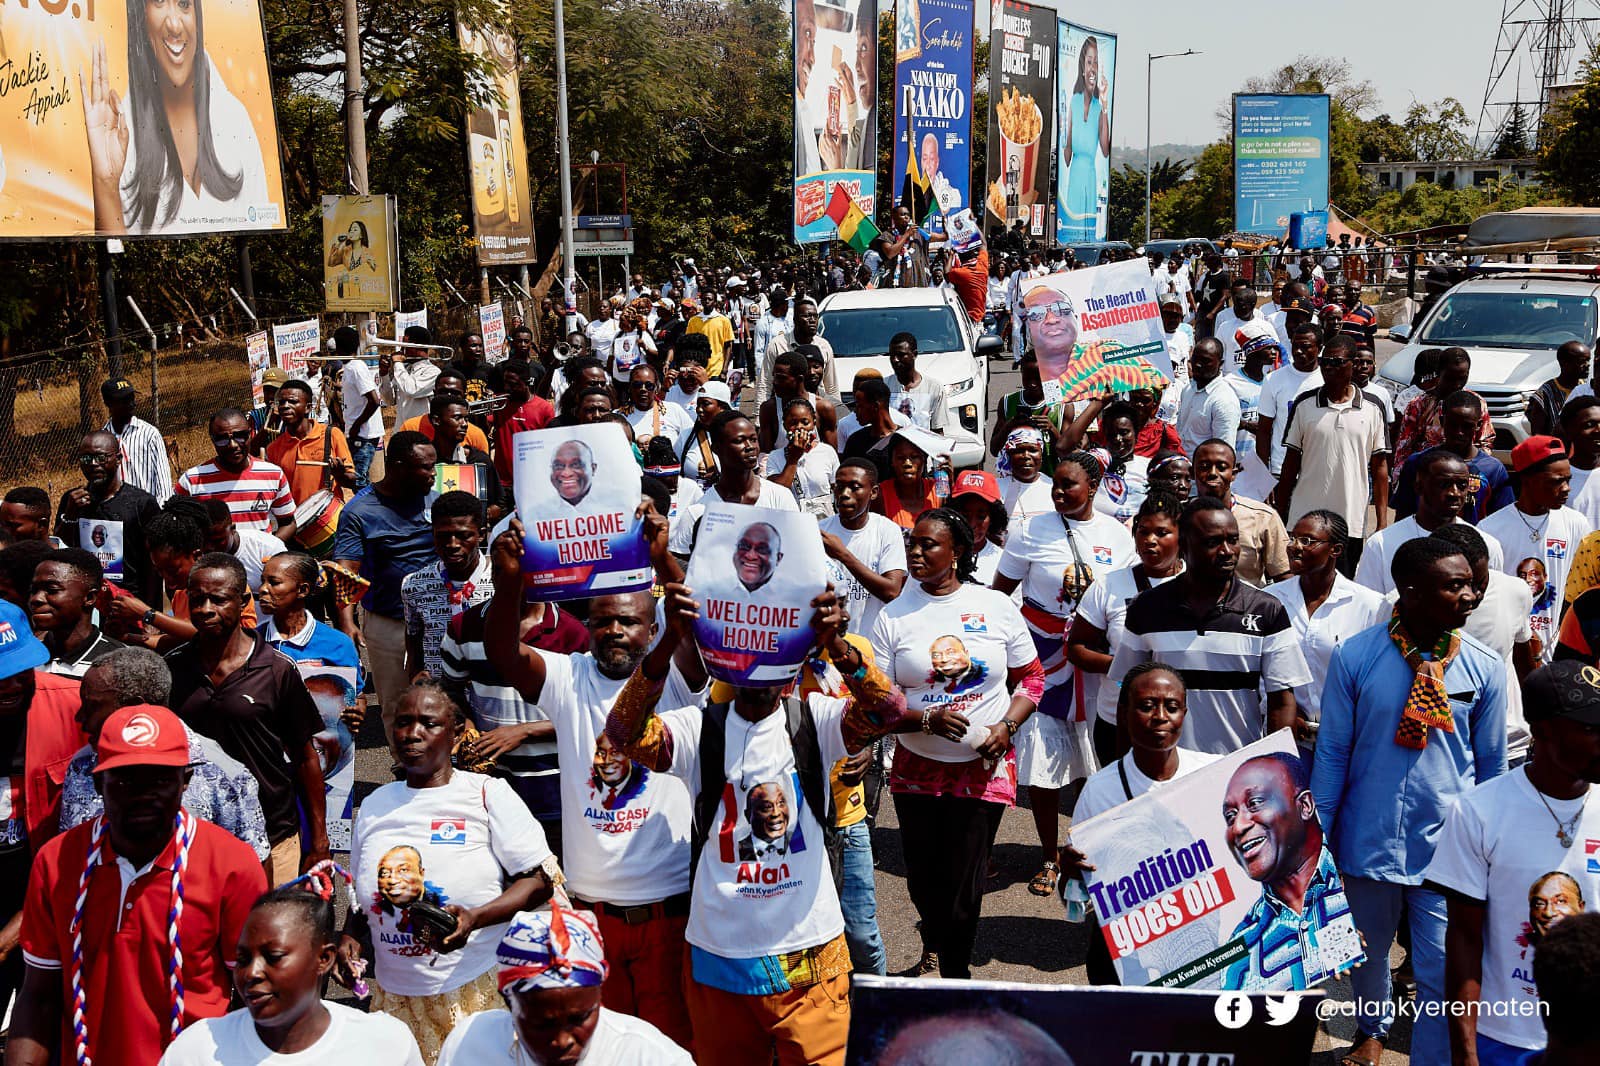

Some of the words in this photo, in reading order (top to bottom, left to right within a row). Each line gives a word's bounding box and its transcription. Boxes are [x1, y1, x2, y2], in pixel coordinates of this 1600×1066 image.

[0, 53, 49, 96] Jackie
[911, 70, 934, 86] NANA
[936, 72, 957, 88] KOFI
[23, 77, 71, 126] Appiah
[1085, 298, 1105, 312] The
[1105, 291, 1135, 309] Heart
[1136, 288, 1147, 301] of
[1081, 301, 1160, 332] Asanteman
[536, 512, 626, 542] WELCOME
[558, 538, 612, 564] HOME
[706, 598, 801, 630] WELCOME
[722, 625, 779, 653] HOME
[921, 694, 952, 703] ALAN
[953, 692, 983, 702] CASH
[584, 807, 616, 822] ALAN
[616, 806, 650, 820] CASH
[602, 821, 632, 834] 2024
[736, 862, 790, 885] Alan
[1088, 838, 1214, 921] Tradition
[736, 886, 755, 896] John
[1110, 891, 1182, 957] goes
[1183, 871, 1224, 914] on
[380, 932, 412, 946] ALAN
[1178, 963, 1207, 983] Kwadwo
[1205, 944, 1245, 968] Kyerematen
